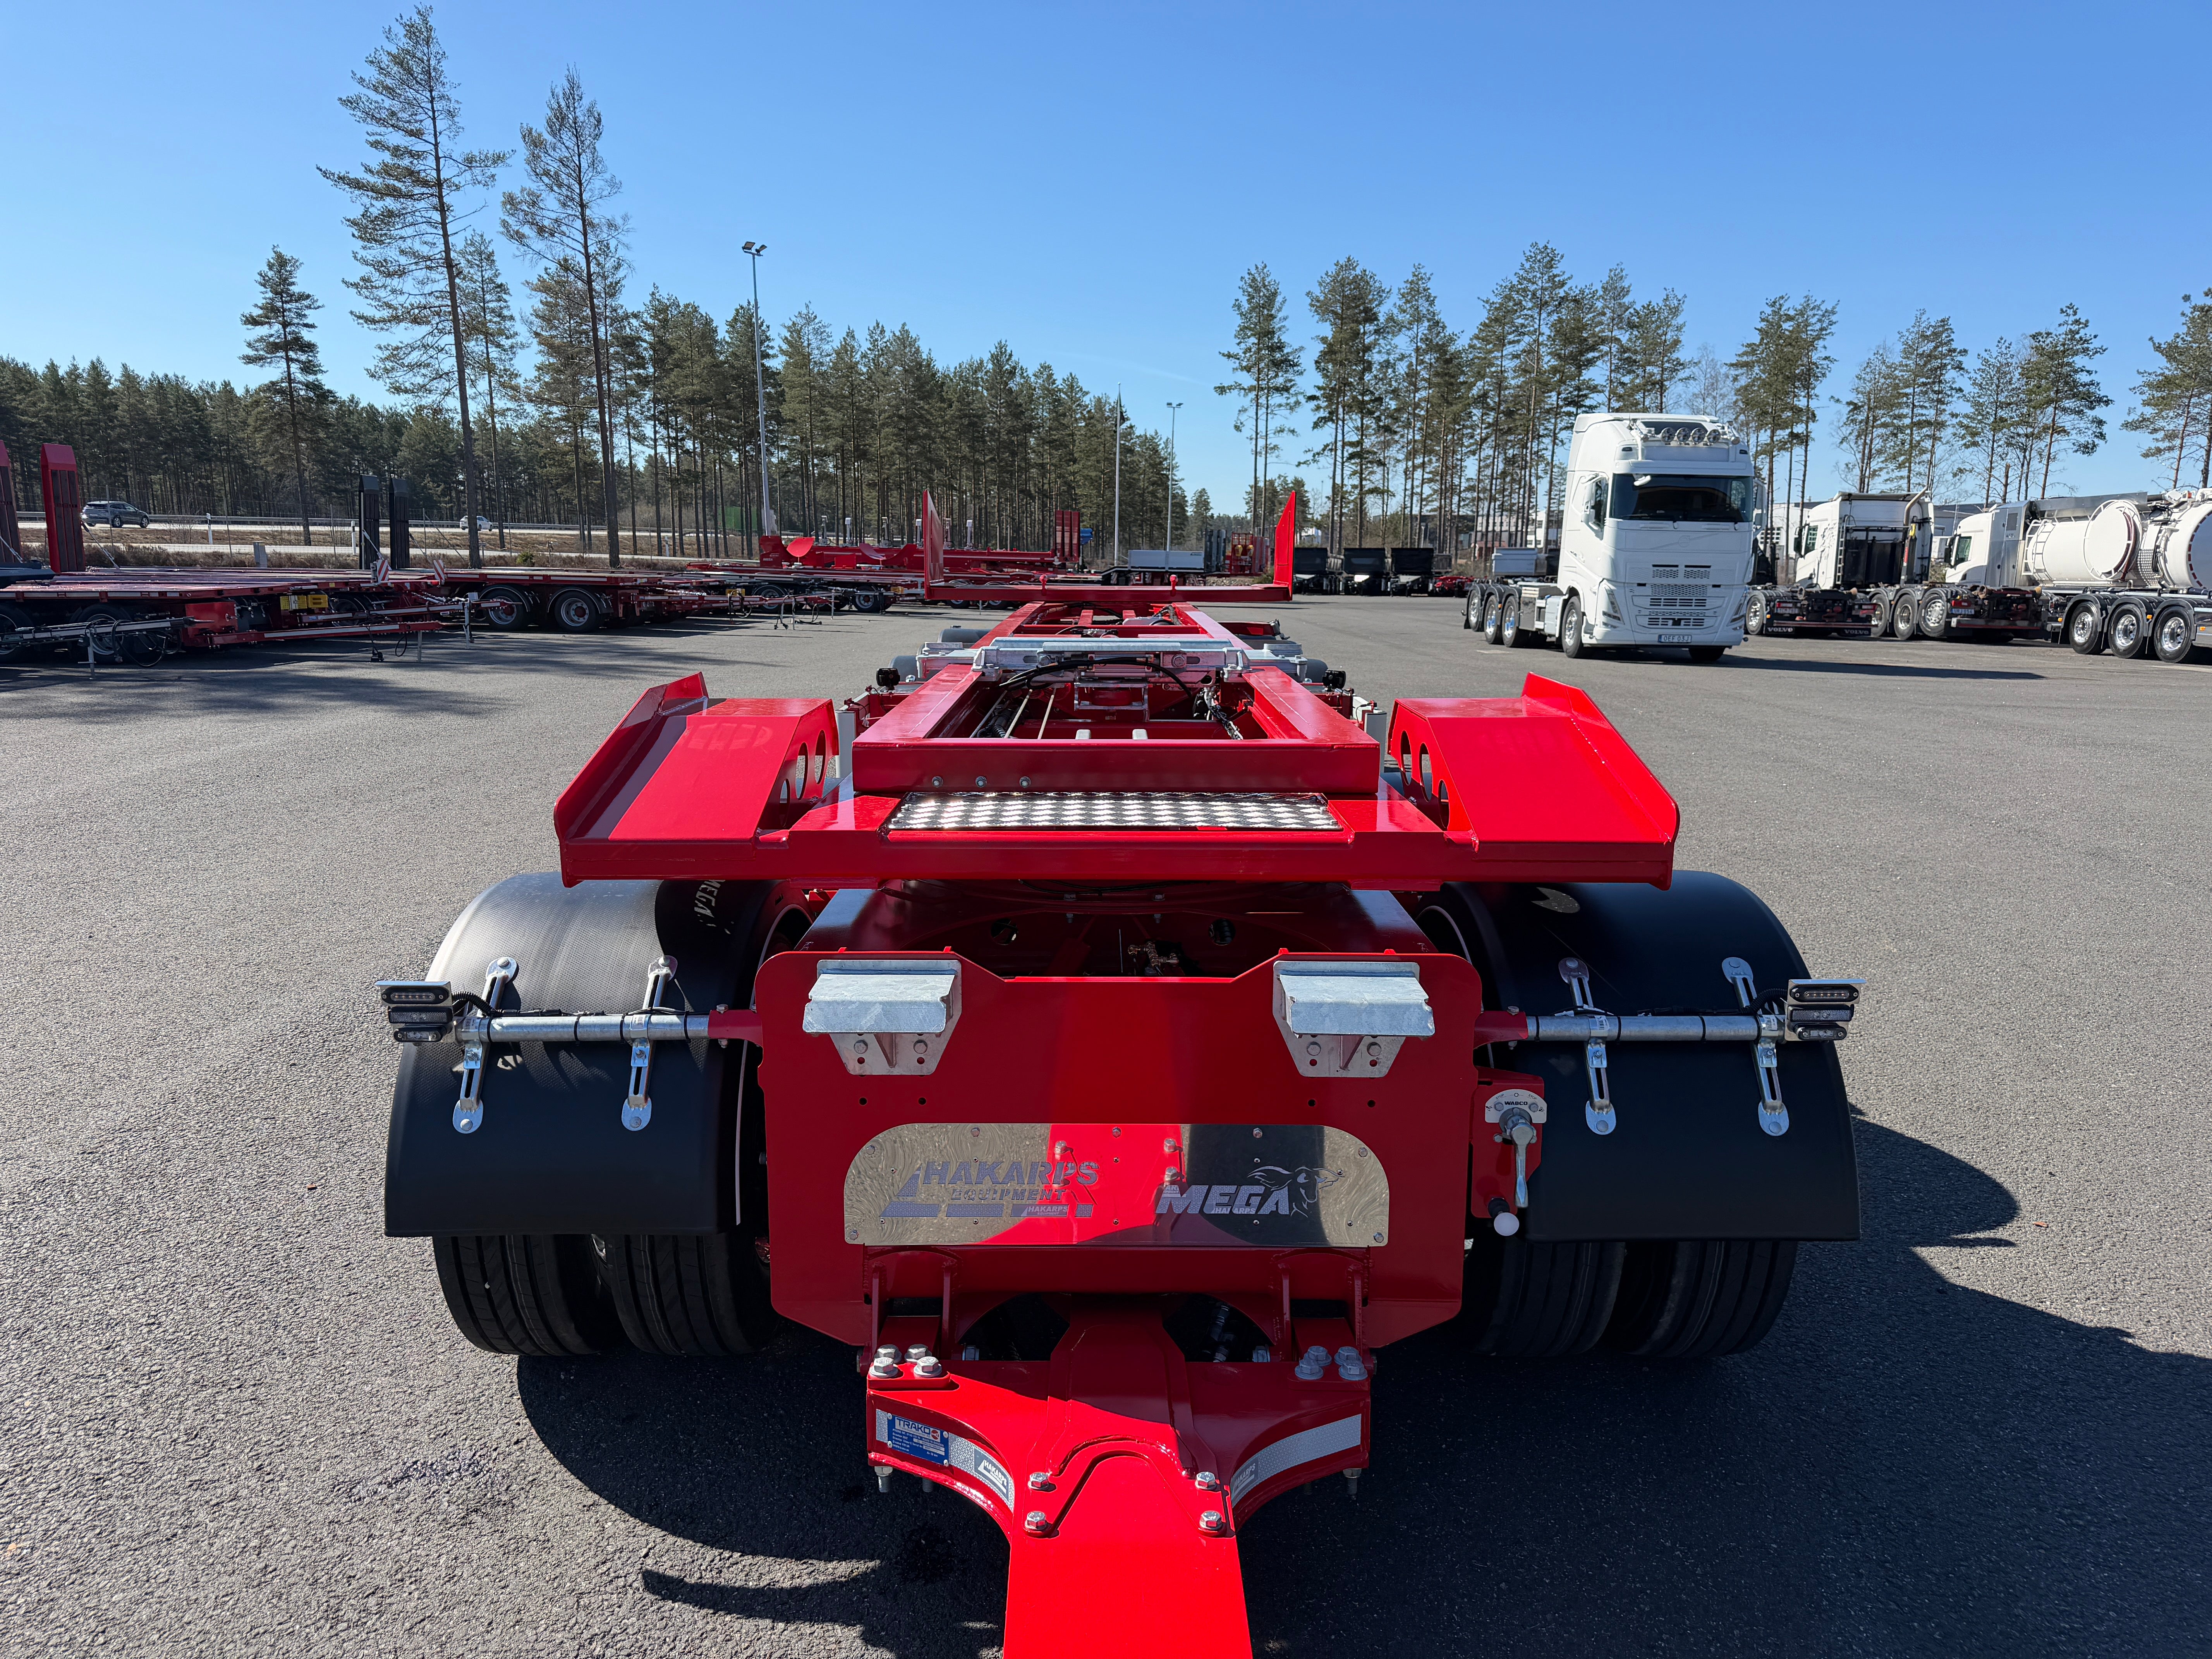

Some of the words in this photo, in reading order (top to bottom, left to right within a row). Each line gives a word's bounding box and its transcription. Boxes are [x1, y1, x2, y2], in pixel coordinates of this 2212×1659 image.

[923, 1161, 1099, 1185] HAKARPS
[951, 1188, 1066, 1200] EQUIPMENT
[1156, 1185, 1290, 1214] MEGA
[896, 1417, 931, 1435] TRAKO
[984, 1460, 1007, 1486] HAKARPS
